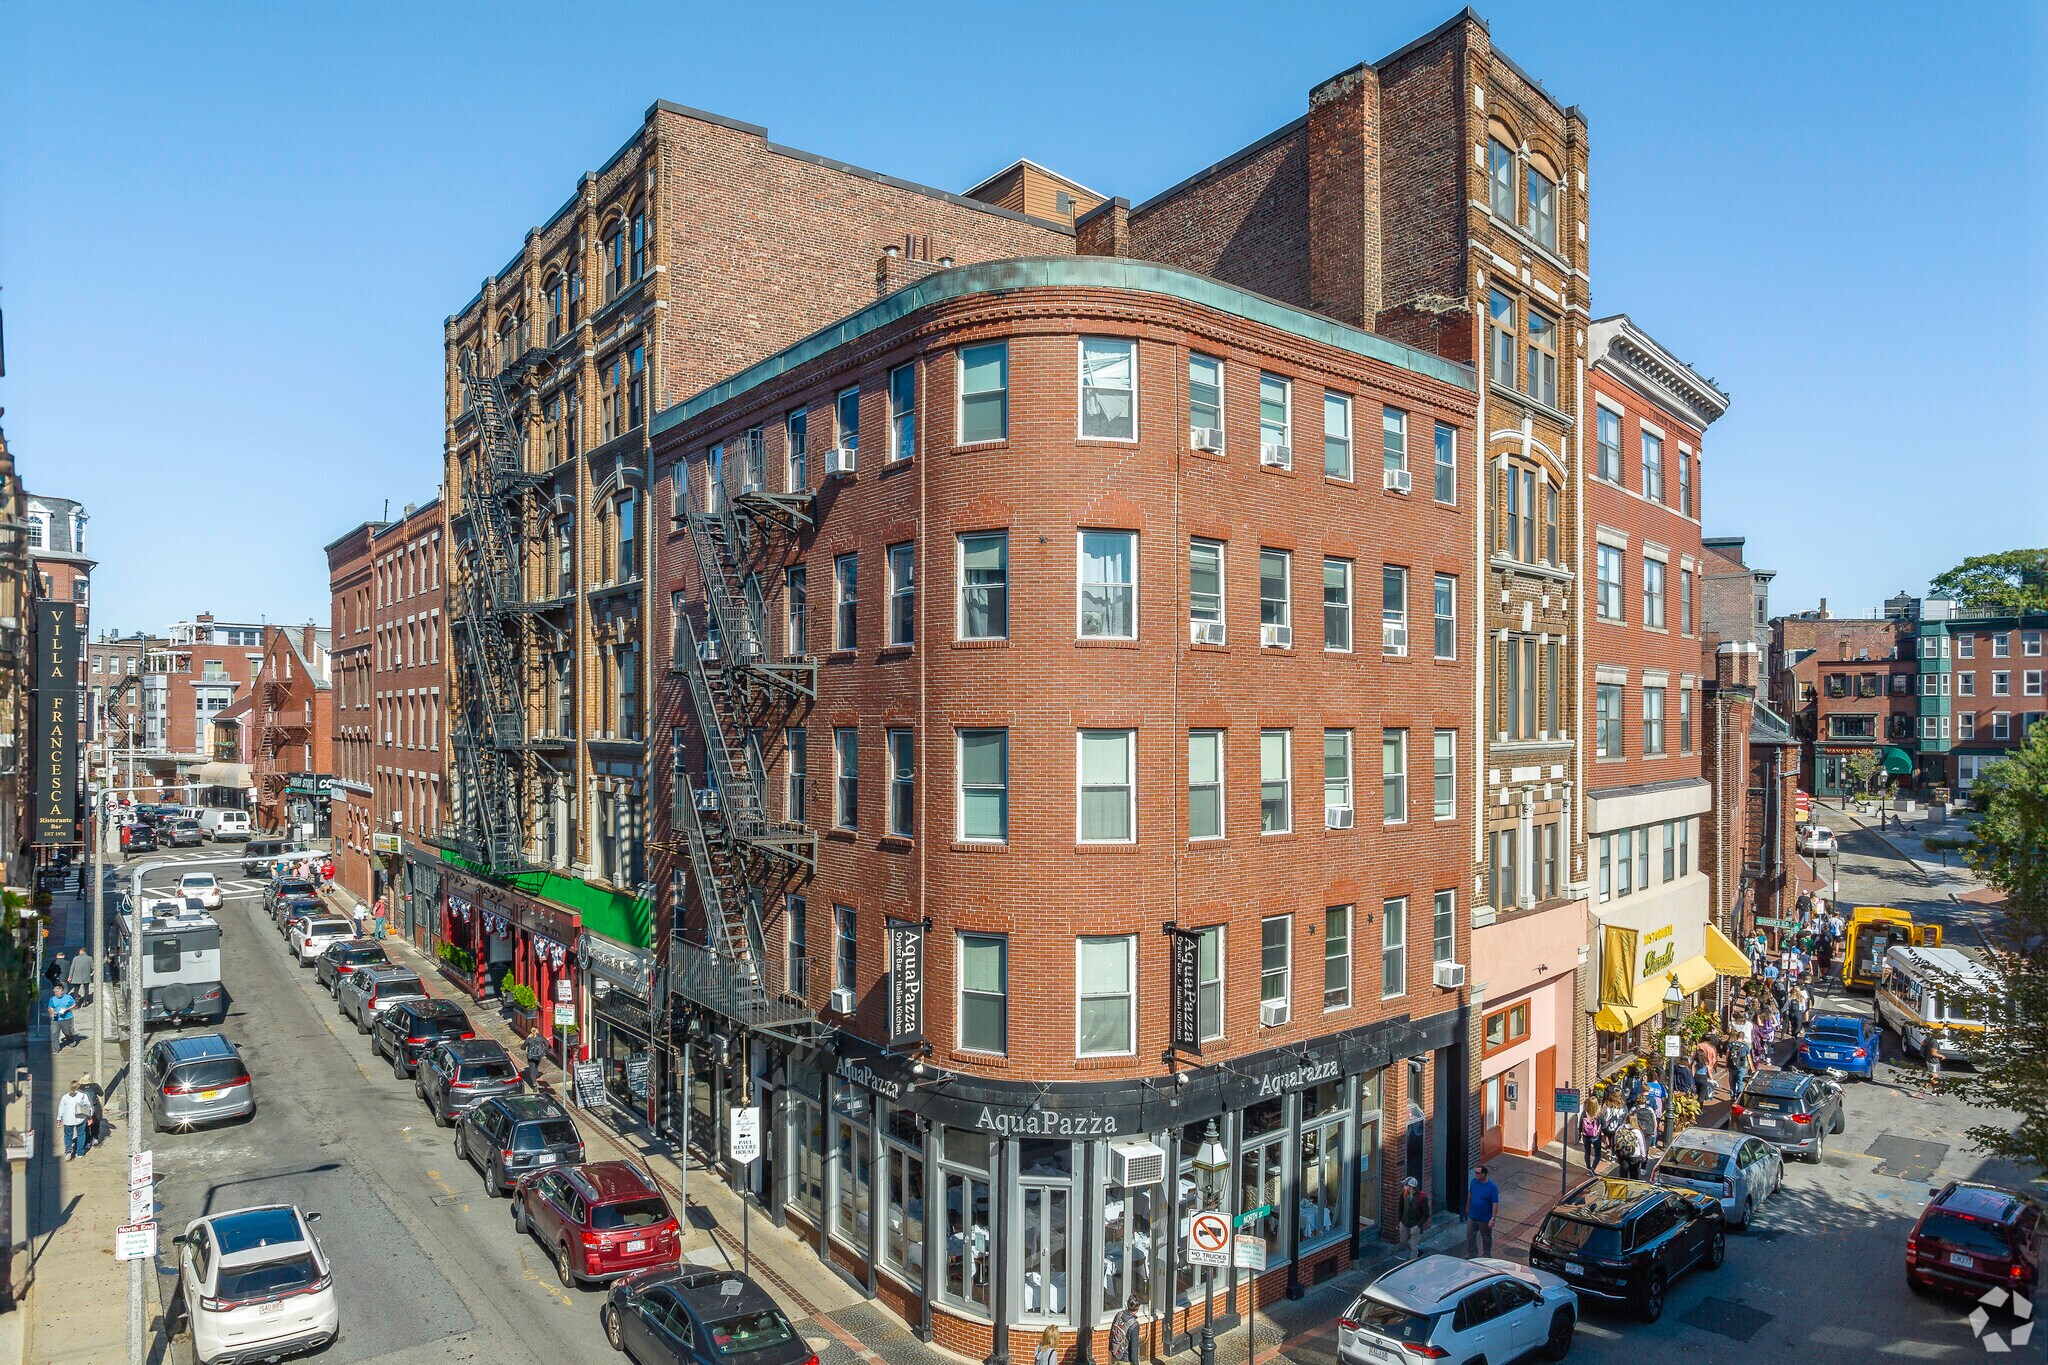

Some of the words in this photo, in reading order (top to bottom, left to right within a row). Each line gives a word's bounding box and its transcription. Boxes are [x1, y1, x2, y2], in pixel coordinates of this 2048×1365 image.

[51, 610, 64, 678] VILLA
[50, 698, 63, 815] FRANCESCA
[895, 932, 903, 957] Oyster
[1176, 936, 1184, 960] Oyster
[902, 930, 920, 1034] AquaPazza
[1182, 936, 1197, 1043] AquaPazza
[896, 1005, 904, 1036] Kitchen
[835, 1058, 900, 1100] AquaPazza
[1259, 1061, 1339, 1096] AquaPazza
[975, 1106, 1118, 1136] AquaPazza
[119, 1224, 139, 1234] North
[140, 1223, 154, 1231] End
[1202, 1252, 1227, 1260] TRUCKS
[1240, 1243, 1260, 1251] Parking
